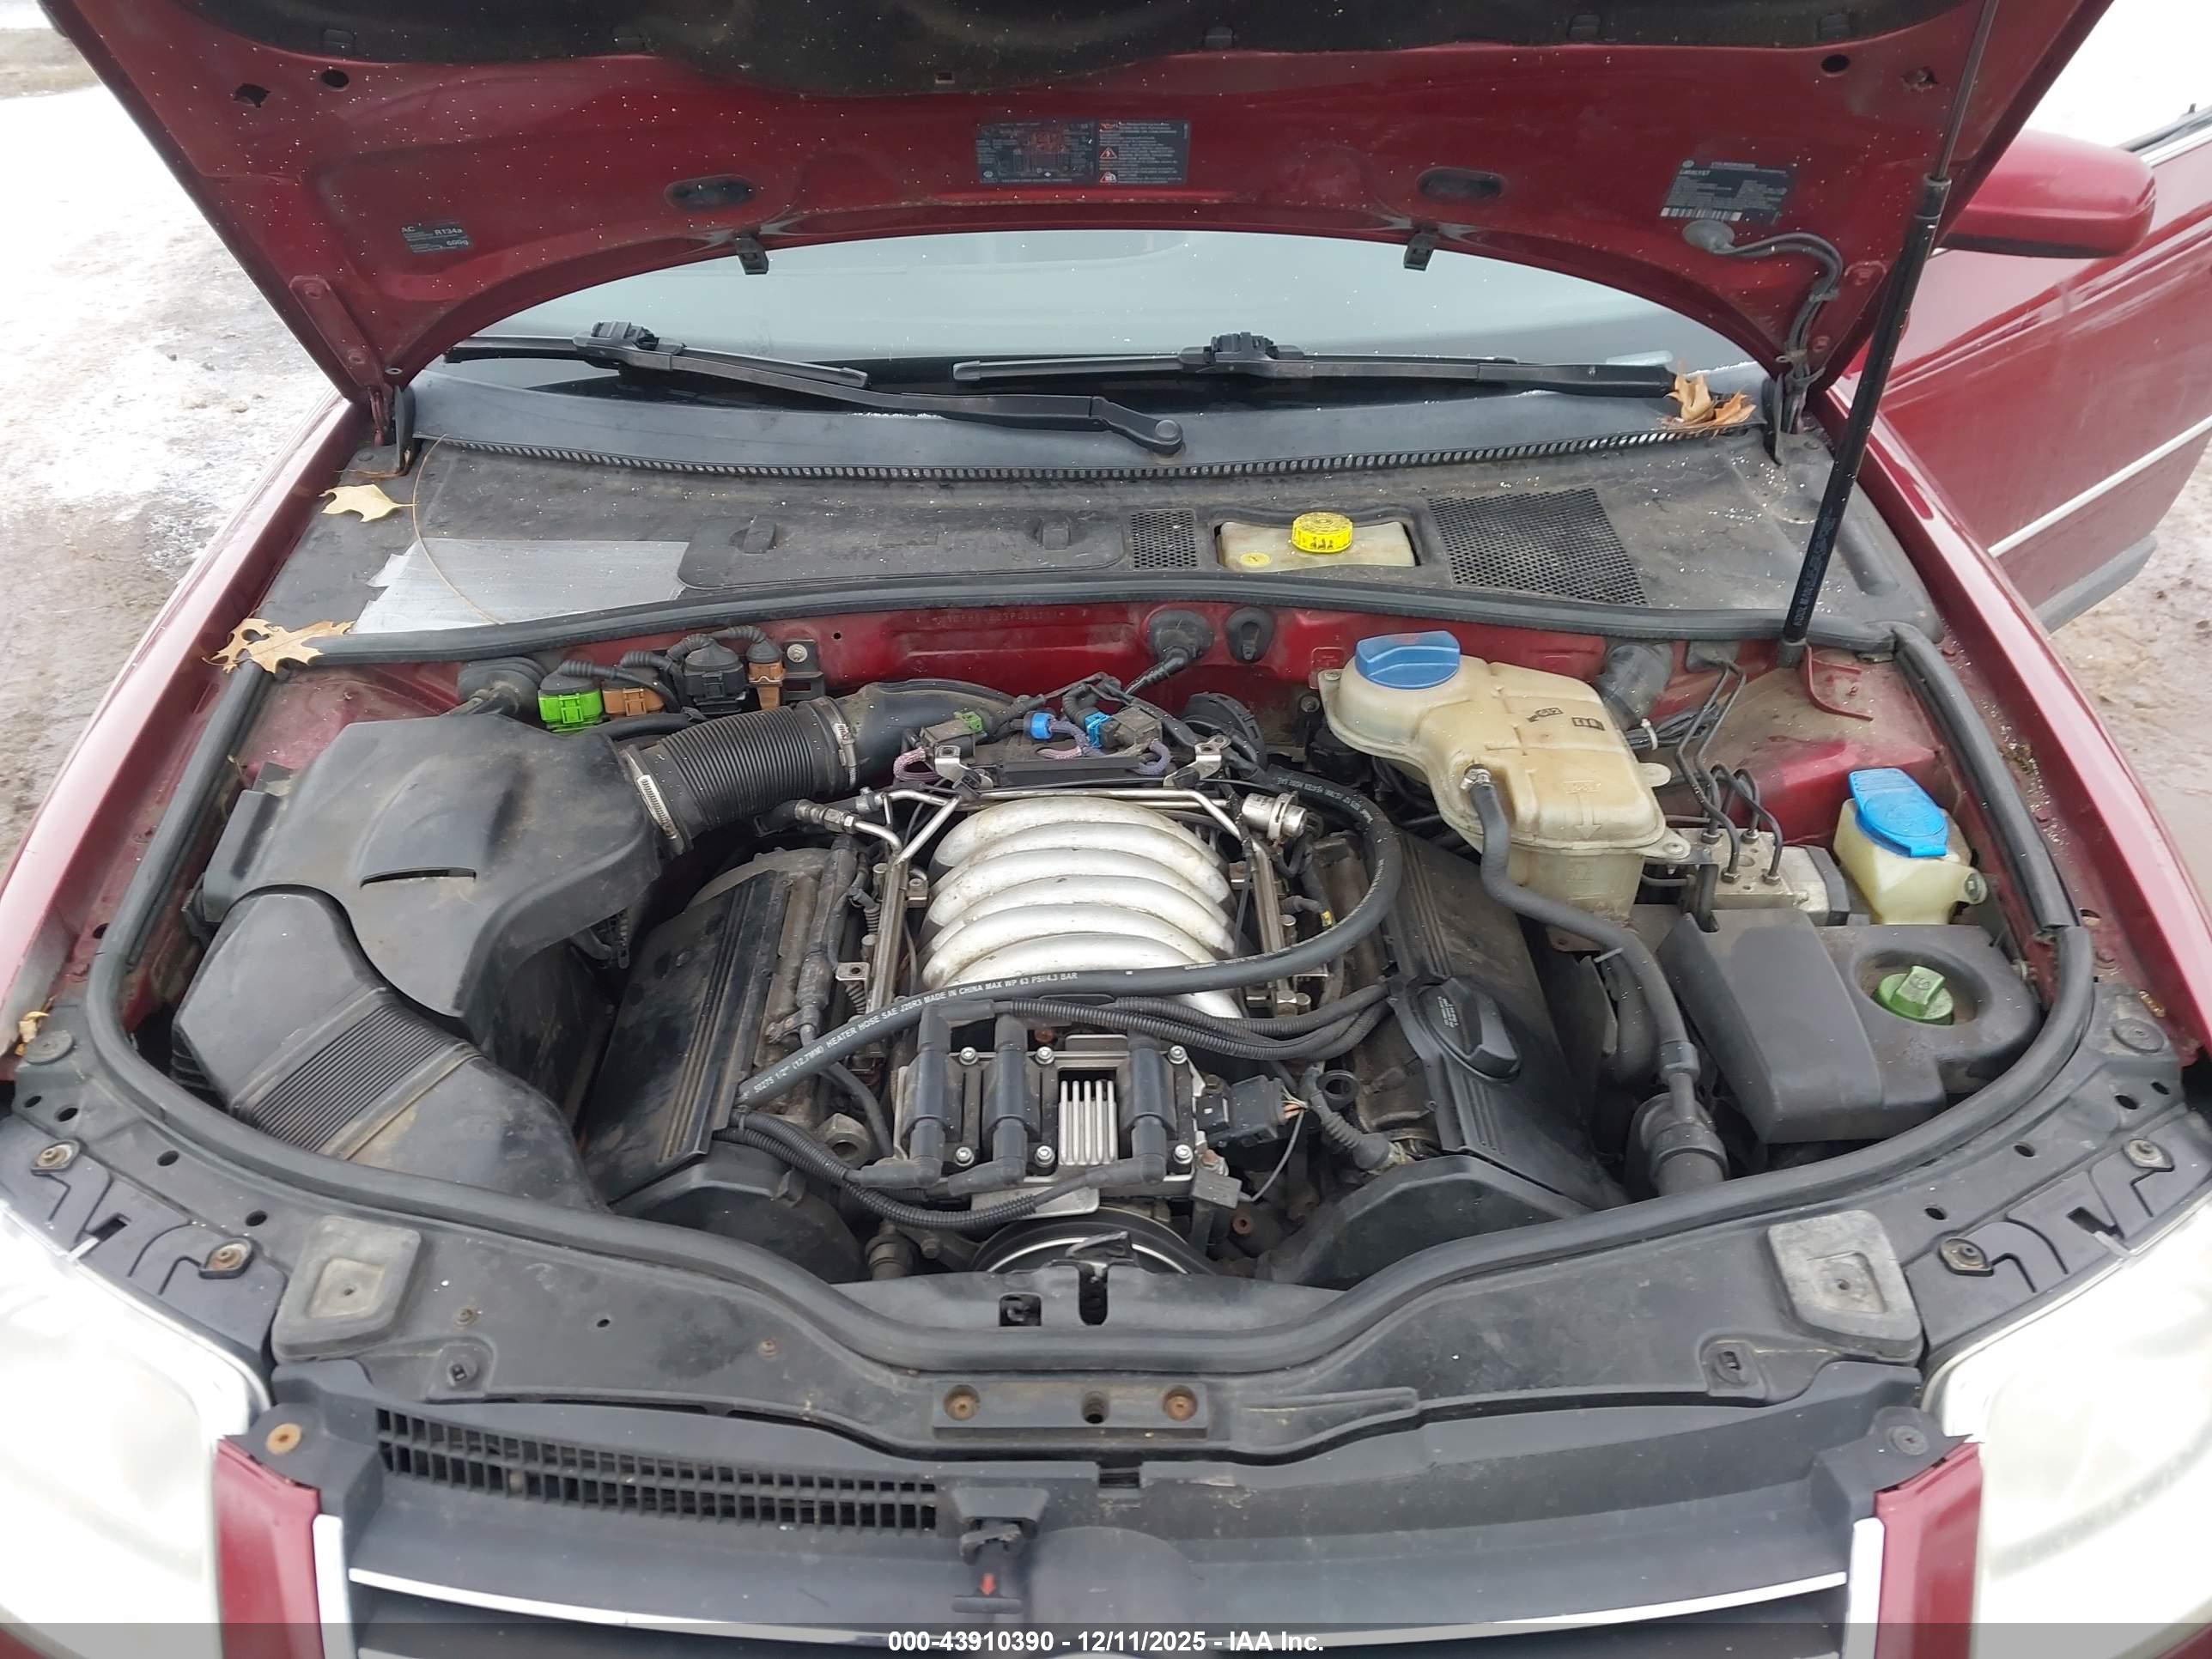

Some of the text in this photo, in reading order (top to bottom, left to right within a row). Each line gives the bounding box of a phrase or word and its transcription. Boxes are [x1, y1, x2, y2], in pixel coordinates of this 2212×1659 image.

[825, 1027, 858, 1048] HEATER
[858, 1015, 881, 1030] HOSE
[881, 1007, 899, 1019] SAE
[923, 992, 947, 1004] MADE
[958, 984, 983, 994] CHINA
[985, 981, 1002, 990] MAX
[1005, 979, 1017, 988] WP
[1060, 972, 1079, 981] BAR
